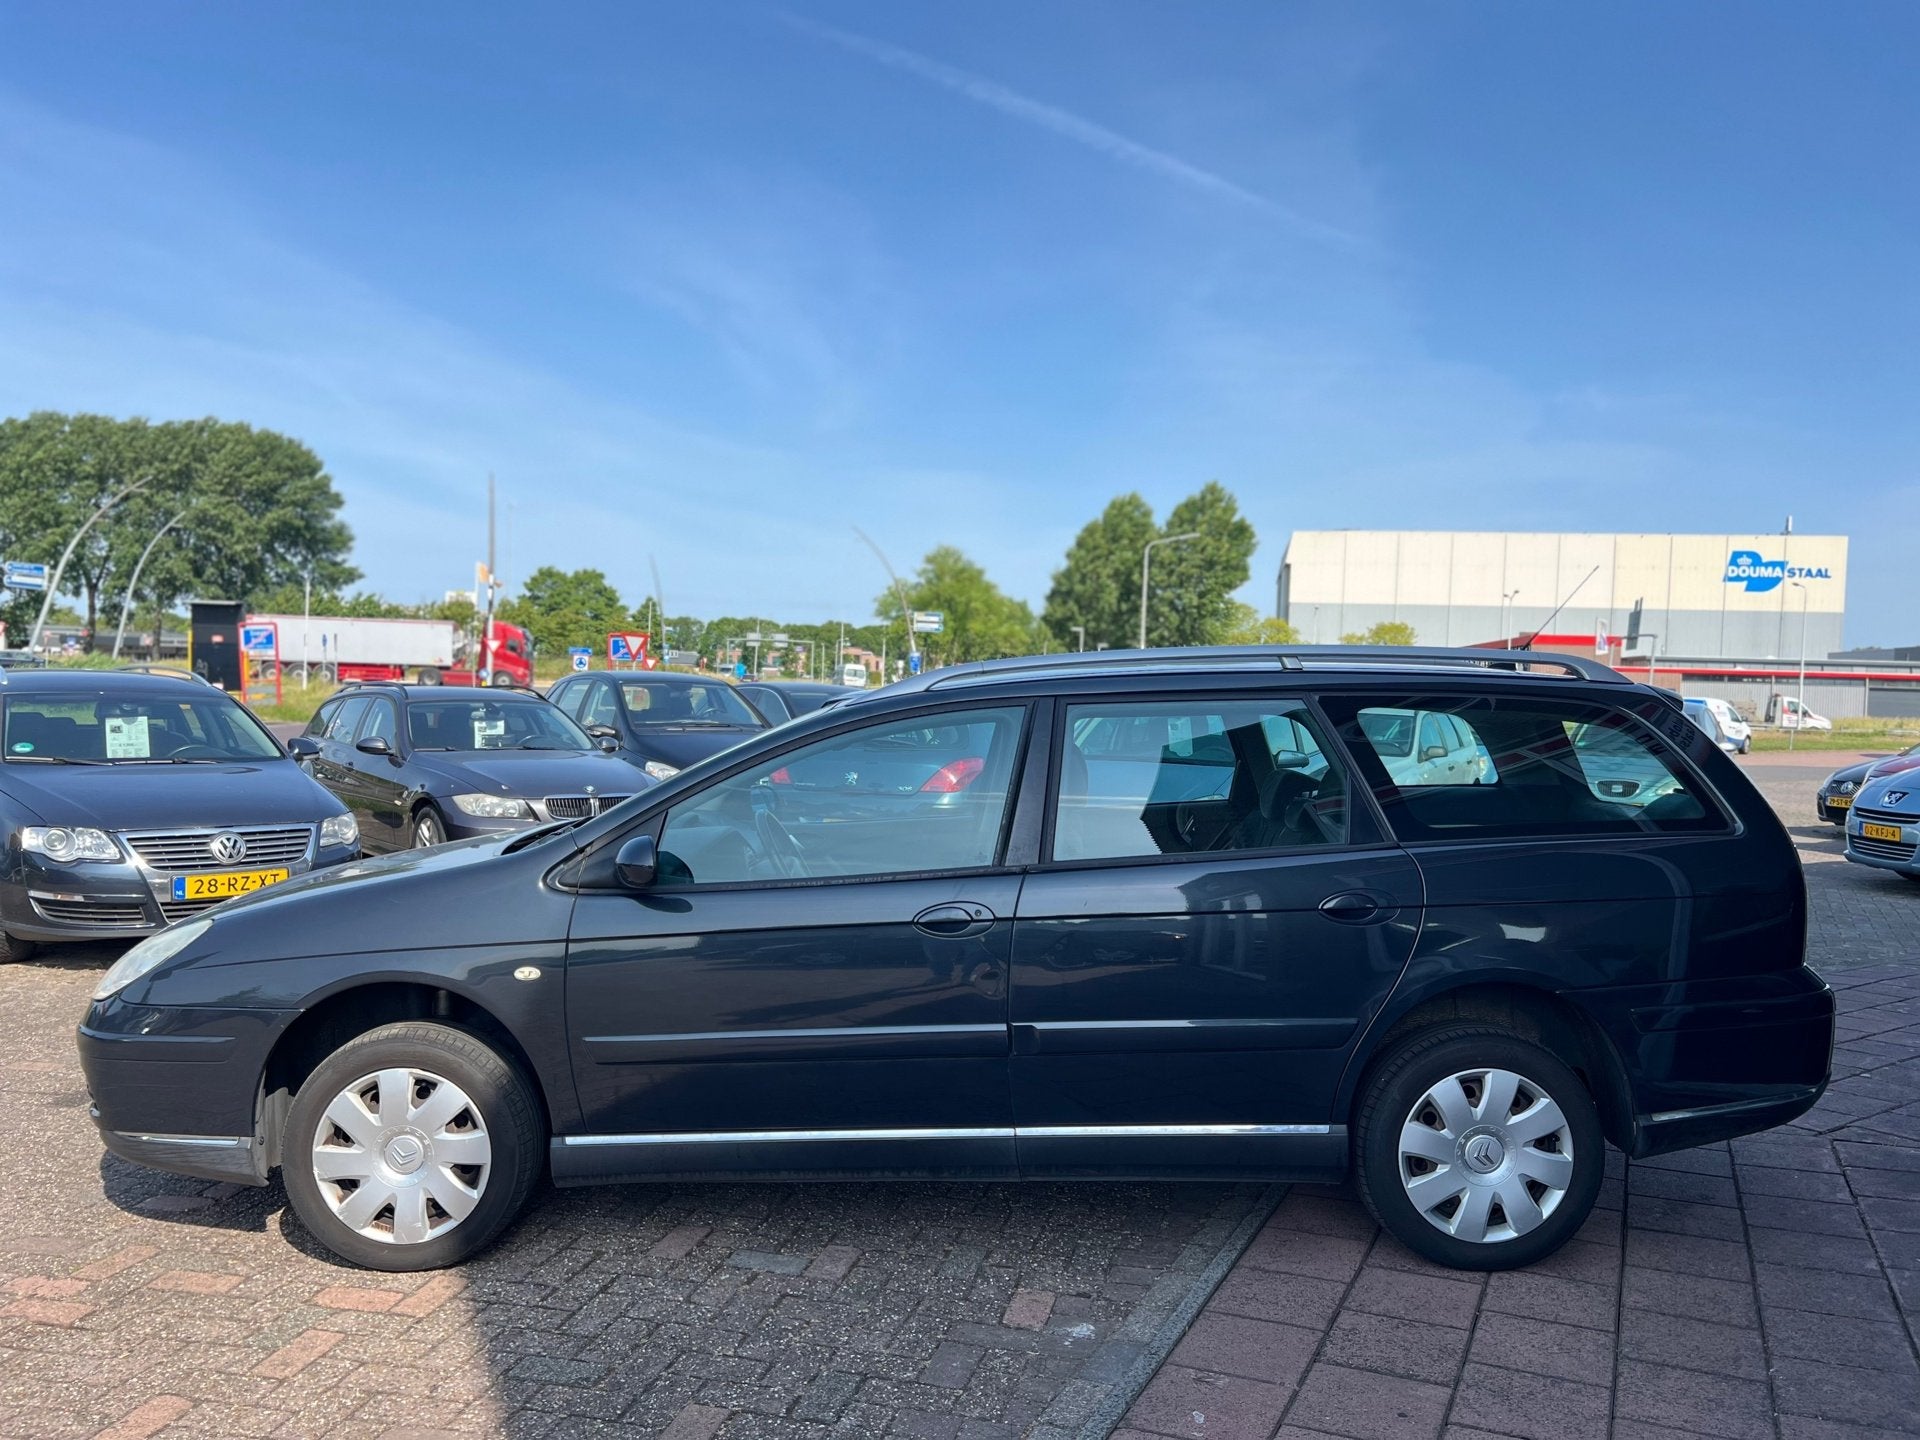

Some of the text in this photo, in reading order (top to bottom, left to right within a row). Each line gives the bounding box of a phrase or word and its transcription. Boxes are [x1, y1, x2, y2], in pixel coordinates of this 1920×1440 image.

[1727, 565, 1832, 579] DOUMA STAAL
[194, 873, 280, 895] 28-RZ-XT
